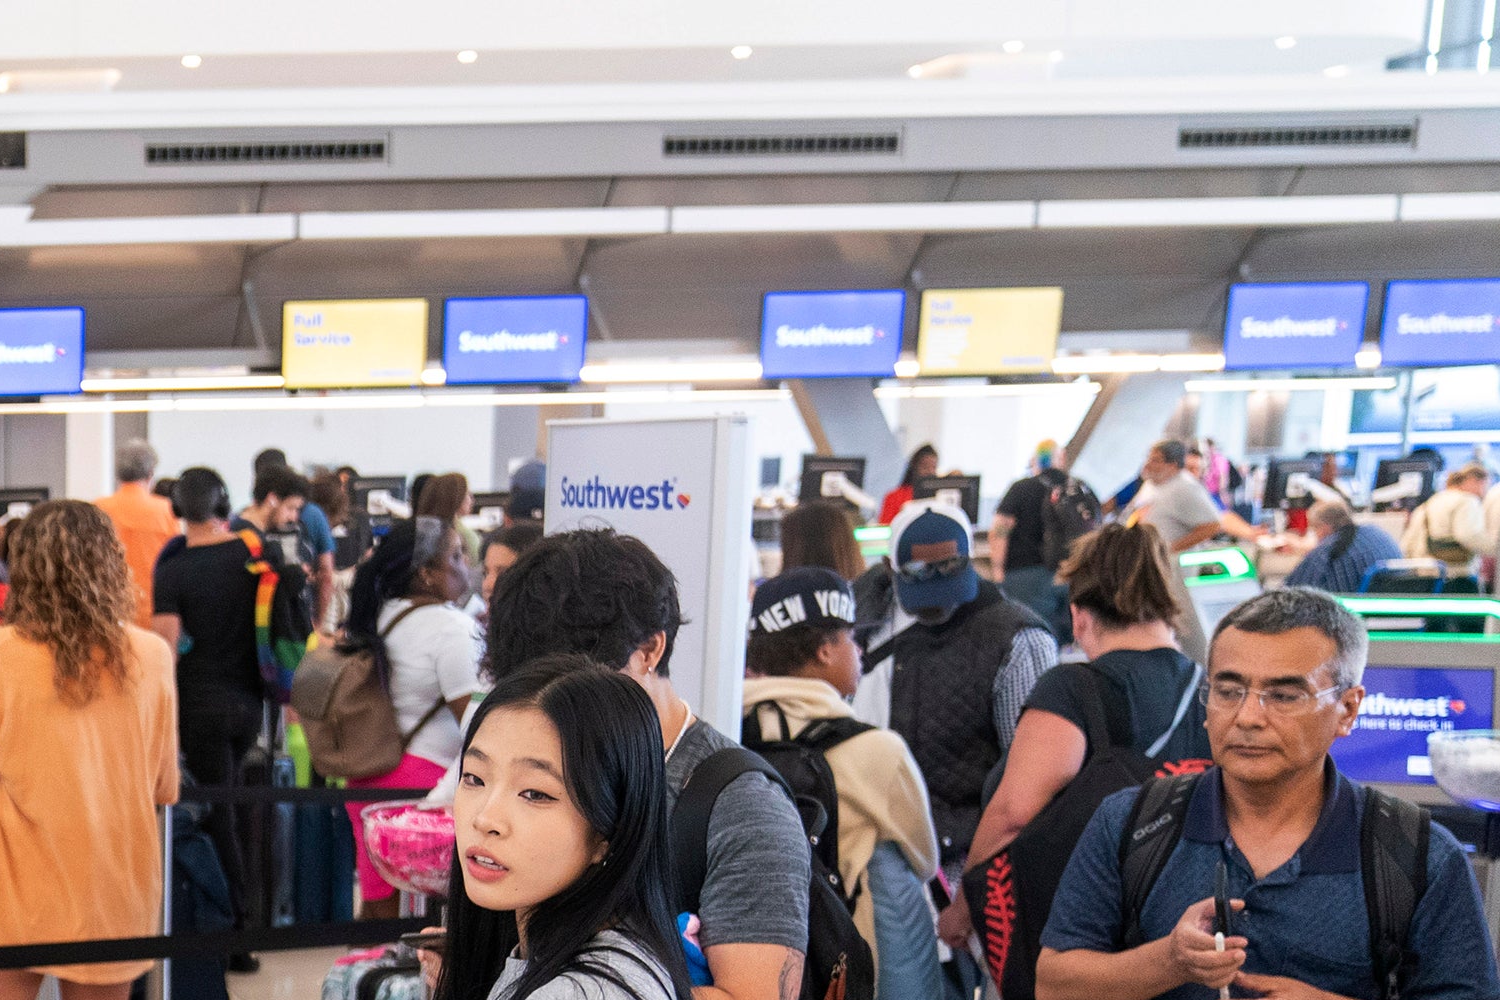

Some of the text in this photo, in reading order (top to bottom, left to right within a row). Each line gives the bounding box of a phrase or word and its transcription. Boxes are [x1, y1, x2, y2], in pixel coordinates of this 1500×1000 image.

[294, 313, 323, 327] Full
[294, 333, 352, 346] Service
[459, 329, 558, 352] Southwest
[776, 323, 874, 347] Southwest
[561, 474, 674, 510] Southwest
[758, 593, 807, 633] NEW
